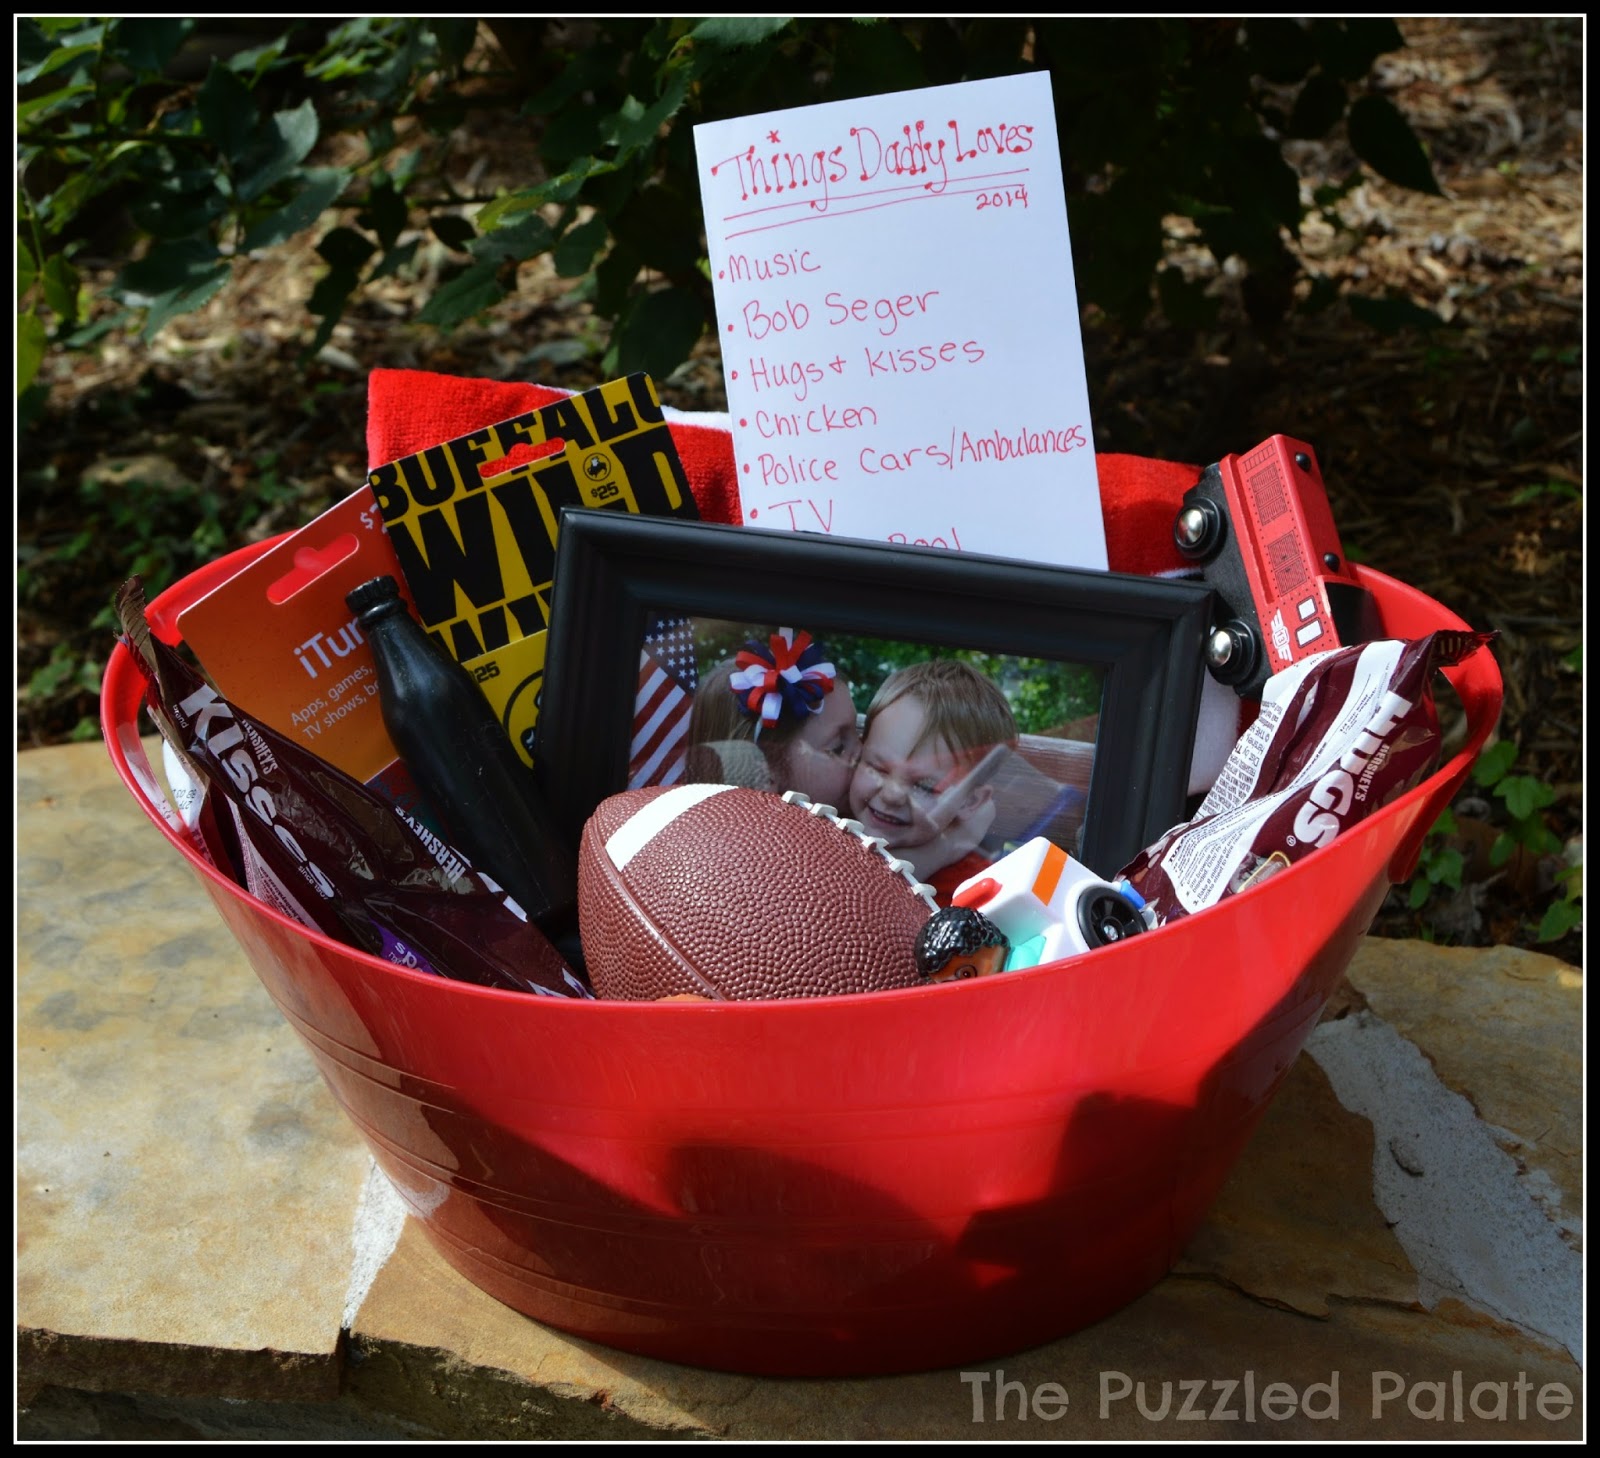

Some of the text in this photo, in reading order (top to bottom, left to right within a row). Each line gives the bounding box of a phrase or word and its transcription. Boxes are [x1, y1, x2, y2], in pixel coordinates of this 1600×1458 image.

[711, 119, 1035, 212] Things Daddy Loves
[976, 184, 1030, 210] 2014
[728, 248, 821, 283] Music
[743, 290, 940, 340] Bob Seger
[749, 356, 824, 402] Hugs
[755, 403, 878, 439] Chicken
[757, 453, 839, 486] Police
[590, 481, 619, 500] $25
[767, 498, 834, 533] TV
[469, 660, 501, 684] 25
[290, 695, 330, 727] Apps,
[328, 664, 374, 703] games,
[303, 695, 368, 741] TV shows,
